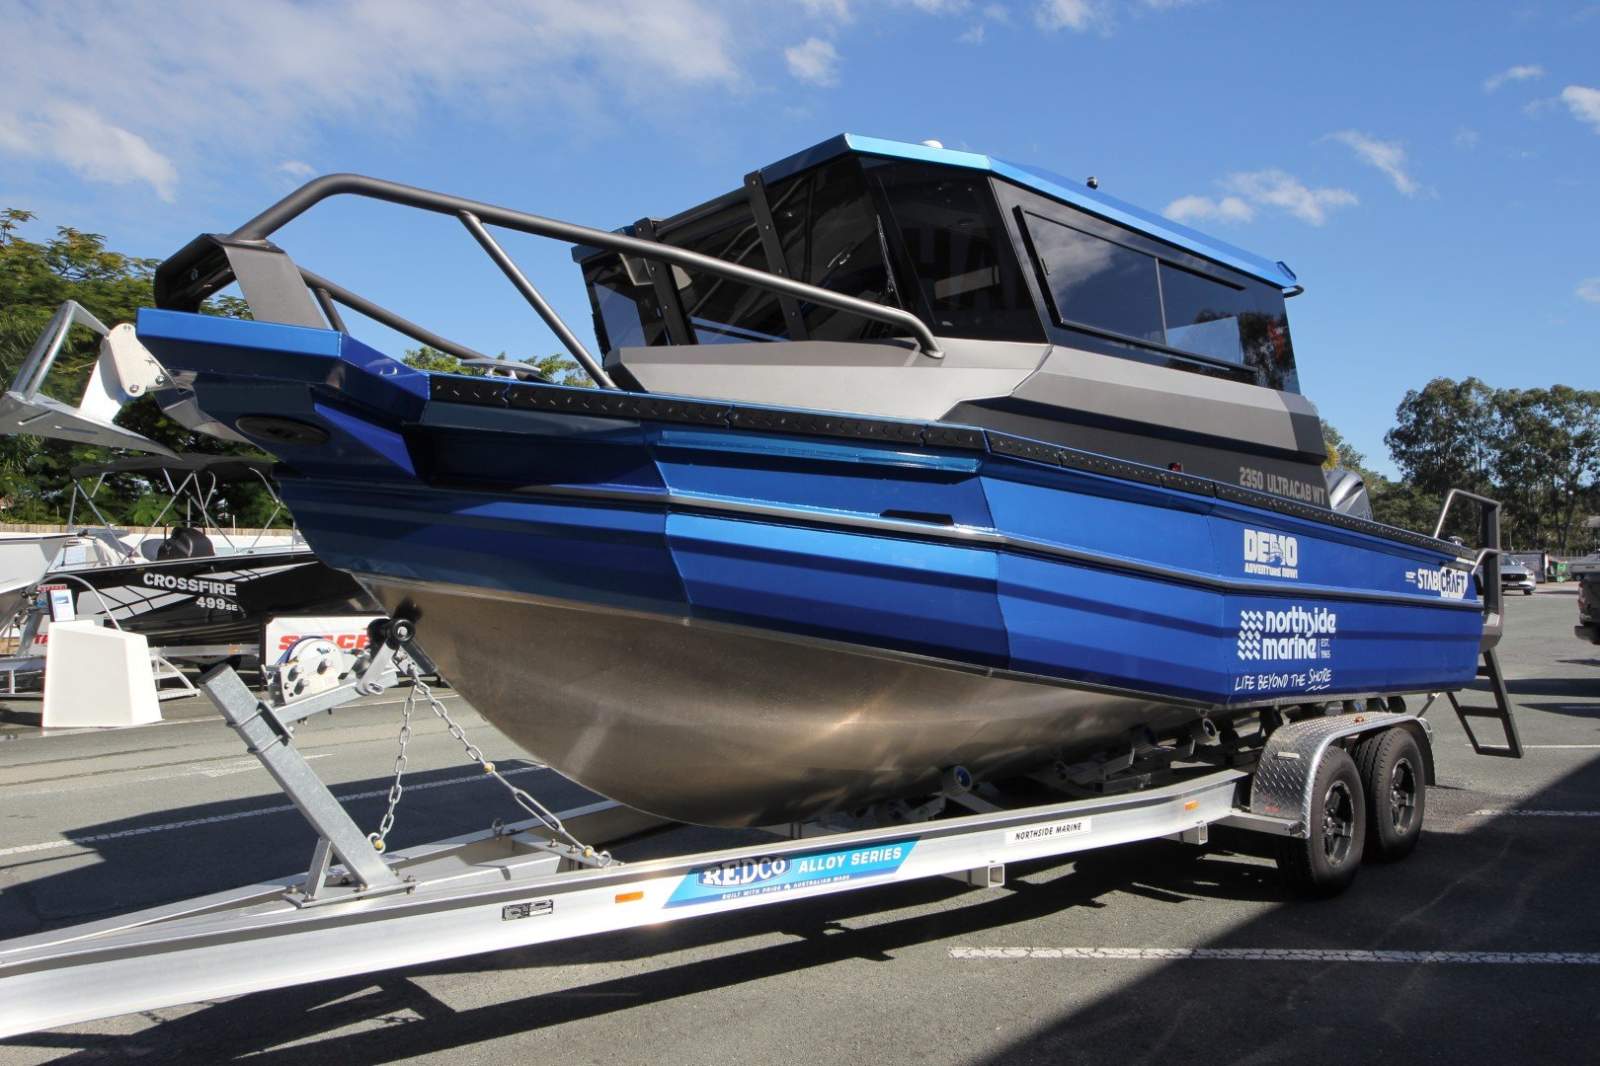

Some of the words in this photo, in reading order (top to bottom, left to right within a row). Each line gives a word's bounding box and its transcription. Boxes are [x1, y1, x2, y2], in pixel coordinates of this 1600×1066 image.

[1239, 466, 1264, 490] 2350
[1267, 473, 1312, 501] ULTRACAB
[1244, 528, 1298, 568] DEMO
[143, 572, 237, 596] CROSSFIRE
[1262, 634, 1317, 660] marine
[1234, 675, 1256, 691] LIFE
[1257, 672, 1289, 690] BEYOND
[1290, 673, 1306, 687] THE
[1015, 827, 1054, 840] NORTHSIDE
[1056, 822, 1082, 833] MARINE
[800, 853, 847, 873] ALLOY
[851, 846, 902, 866] SERIES
